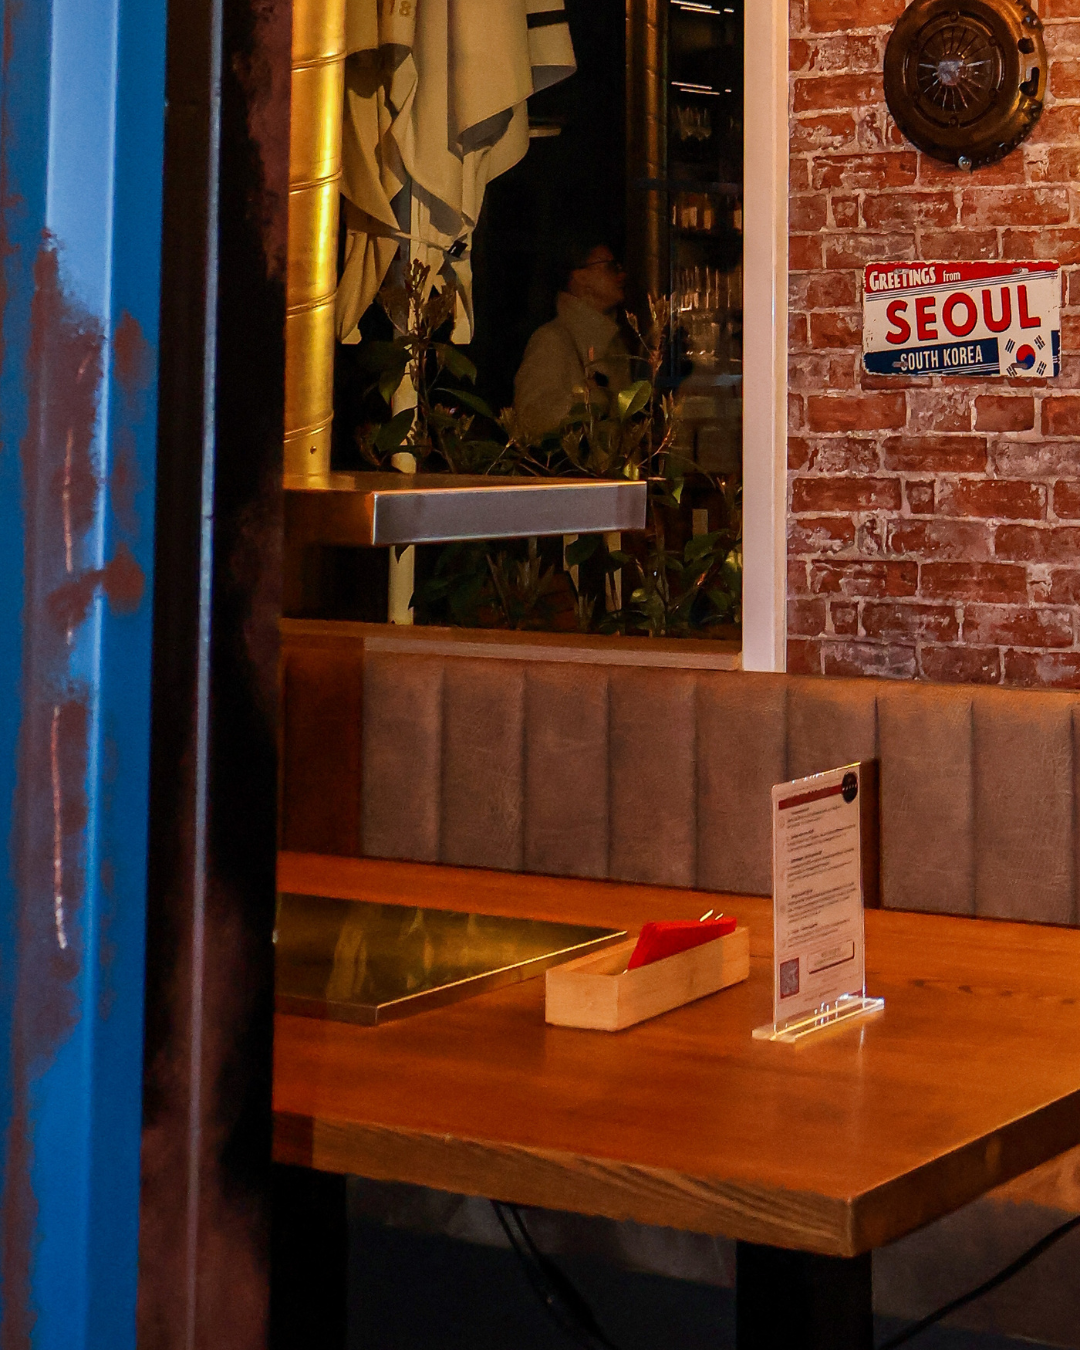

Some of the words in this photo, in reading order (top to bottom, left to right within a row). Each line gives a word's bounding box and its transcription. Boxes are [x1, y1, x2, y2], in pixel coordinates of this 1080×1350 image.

[869, 266, 937, 291] GREETINGS
[943, 270, 961, 283] from
[885, 284, 1042, 345] SEOUL
[900, 350, 939, 372] SOUTH
[943, 344, 984, 367] KOREA
